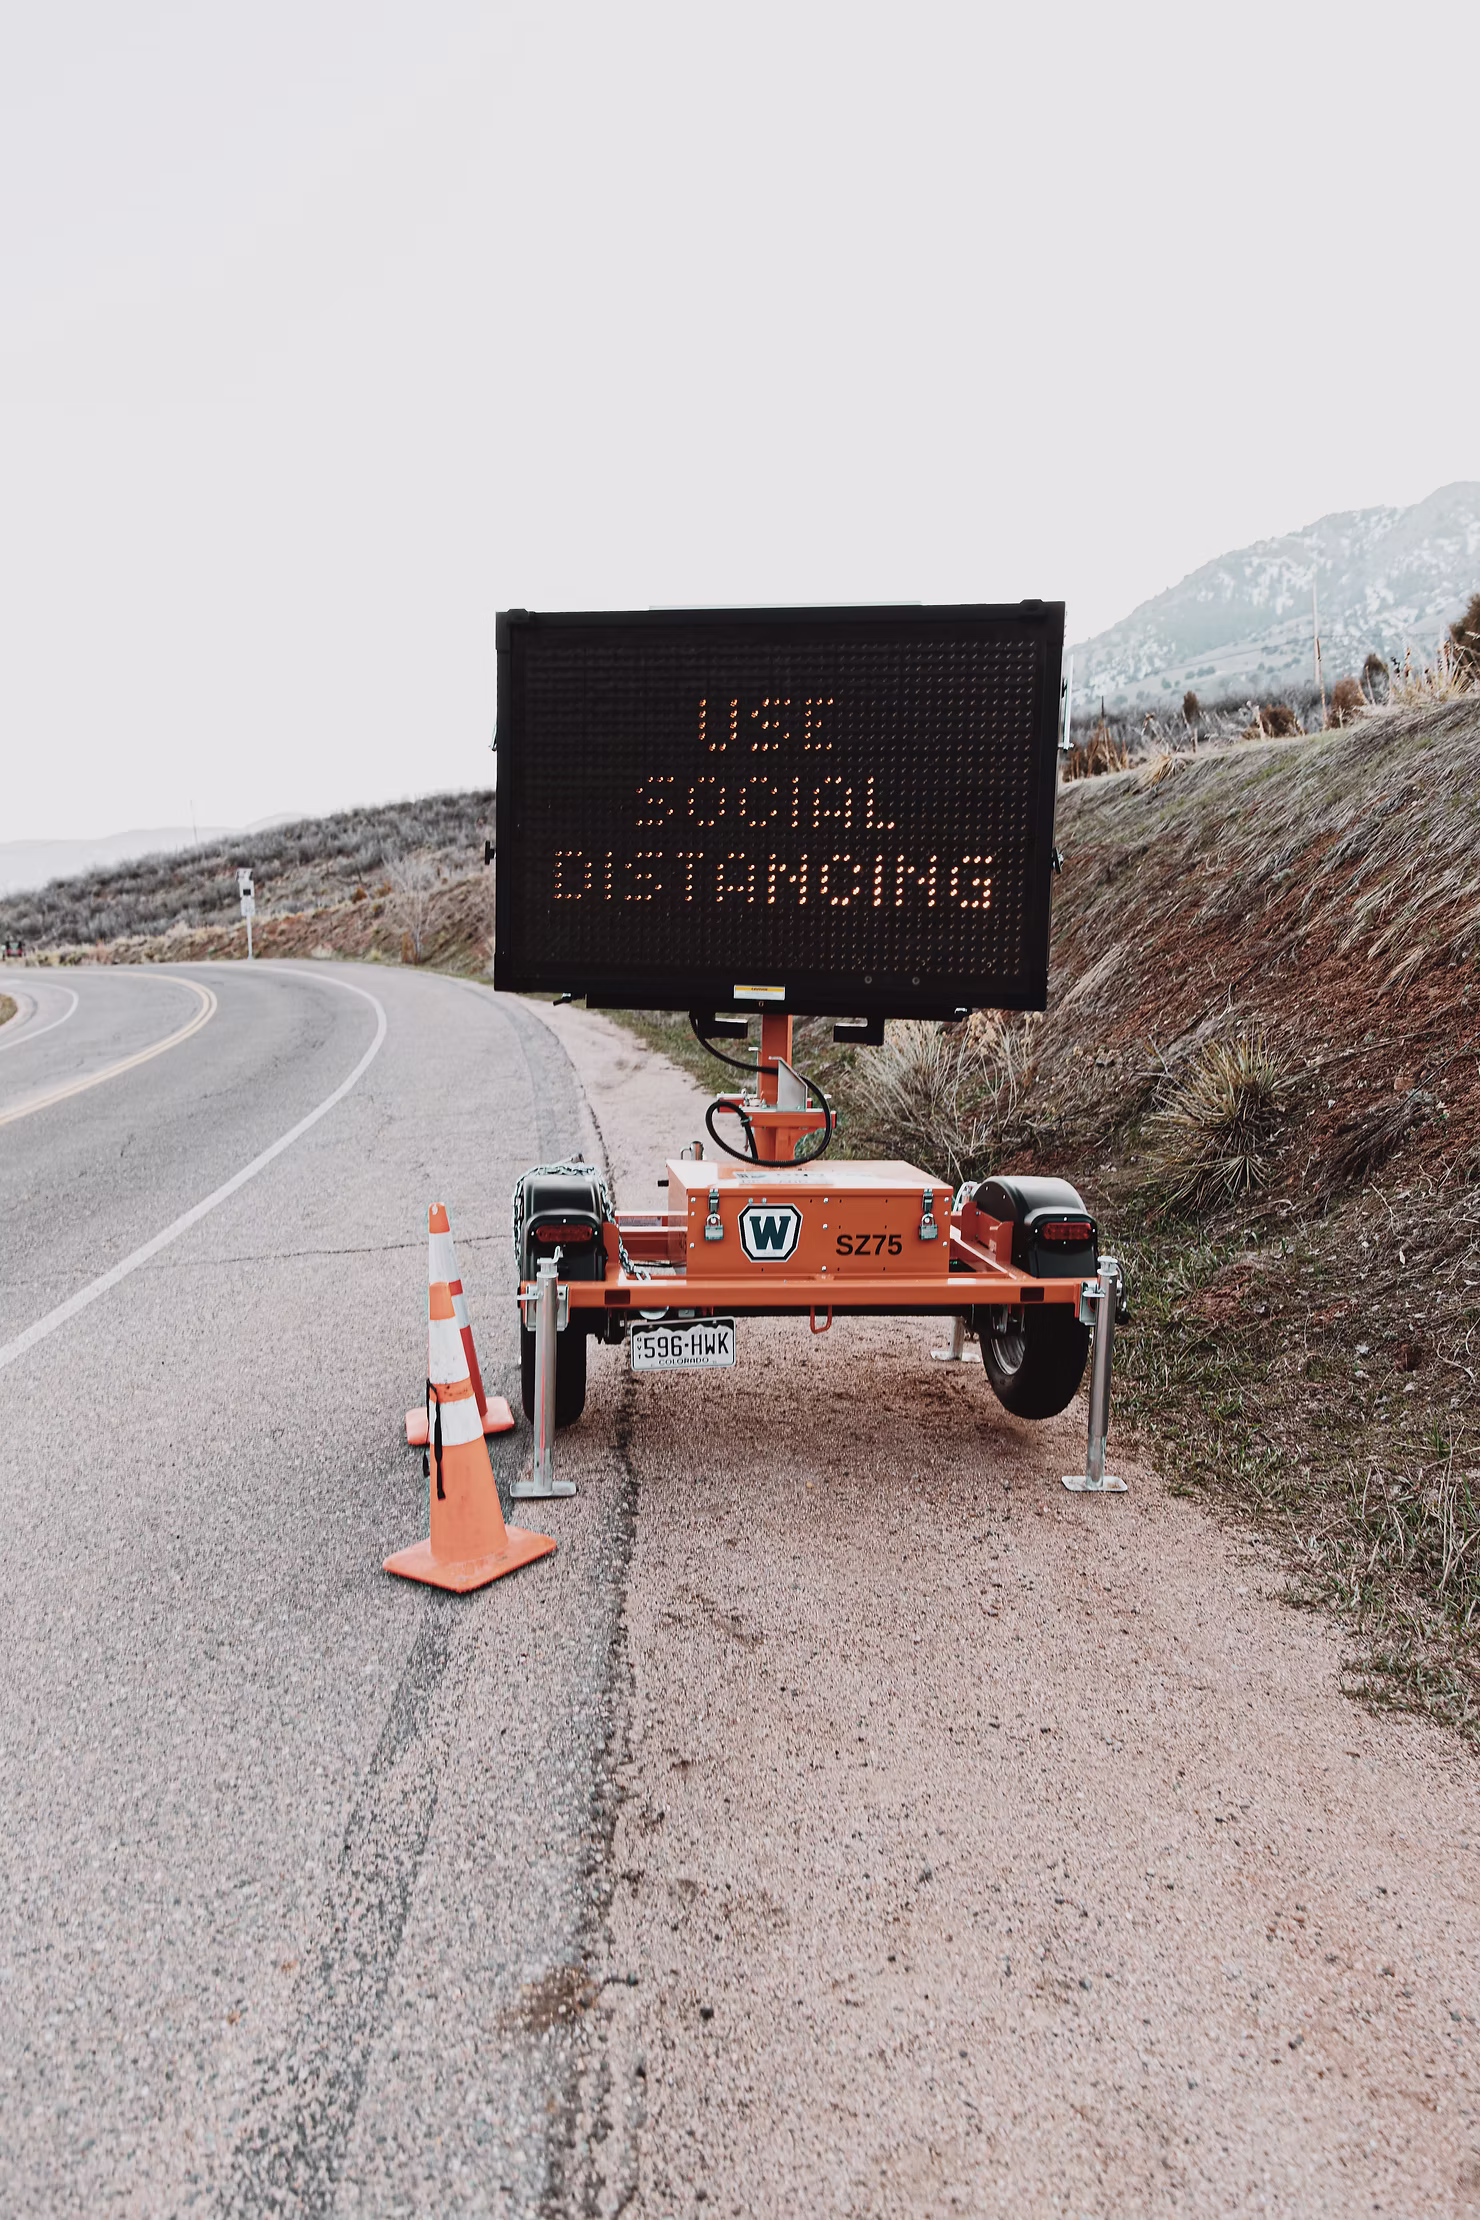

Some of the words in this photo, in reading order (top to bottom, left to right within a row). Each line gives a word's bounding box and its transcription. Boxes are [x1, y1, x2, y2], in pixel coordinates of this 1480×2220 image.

[698, 698, 833, 751] USE
[635, 776, 894, 829] SOCIAL
[553, 851, 993, 909] DISTANCING
[749, 1216, 791, 1250] W
[835, 1234, 903, 1256] SZ75
[658, 1357, 709, 1366] COLORADO
